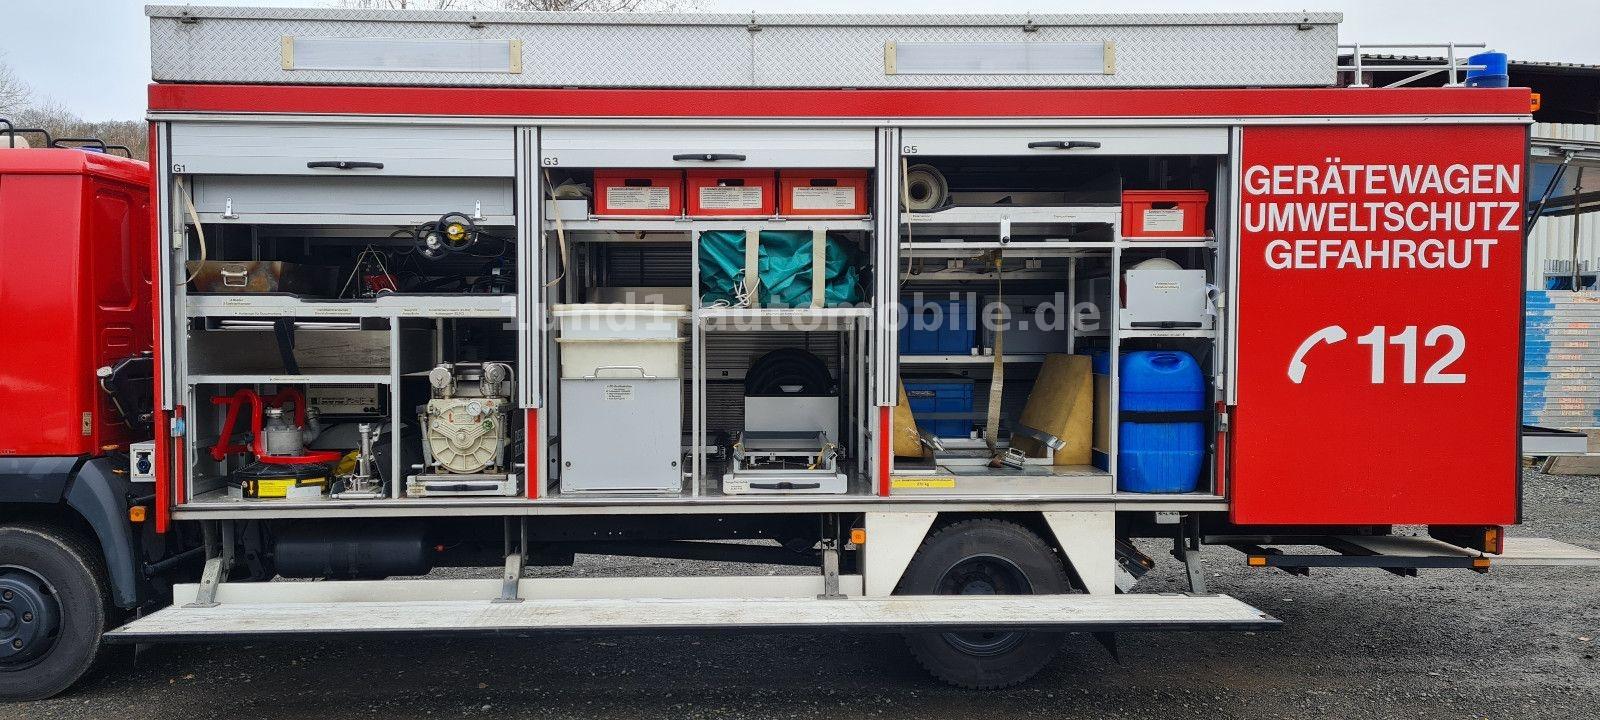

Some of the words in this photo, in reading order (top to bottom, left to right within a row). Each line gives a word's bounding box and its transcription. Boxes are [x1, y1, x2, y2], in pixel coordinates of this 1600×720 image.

[544, 157, 558, 166] G3
[904, 145, 918, 154] G5
[173, 163, 186, 173] G1
[1244, 157, 1520, 195] GERÄTEWAGEN
[1245, 201, 1520, 233] UMWELTSCHUTZ
[1265, 238, 1498, 269] GEFAHRGUT
[1357, 324, 1467, 384] 112
